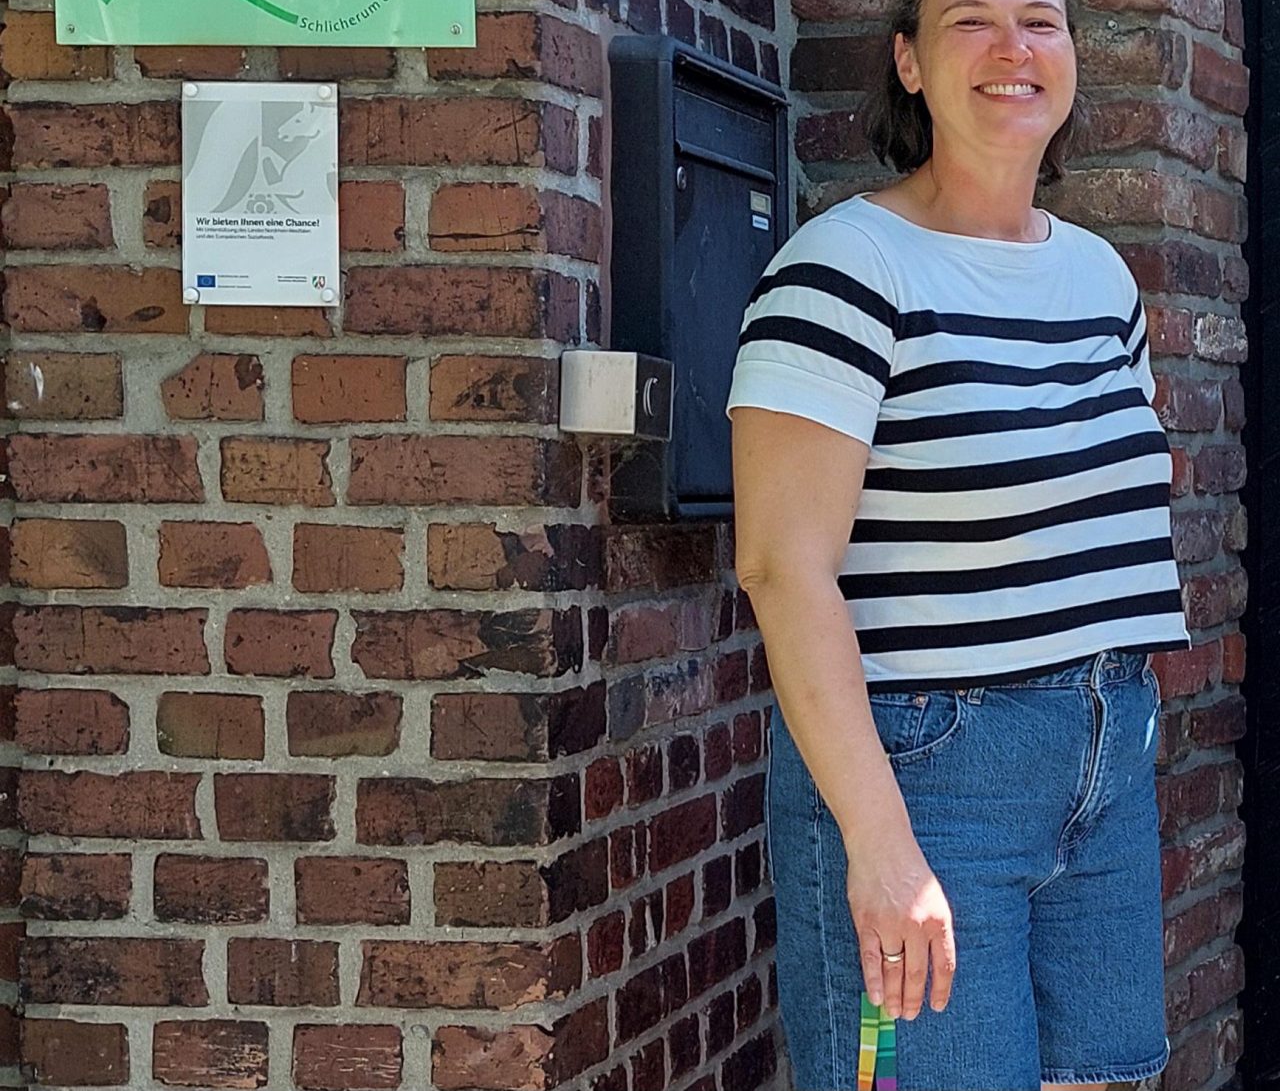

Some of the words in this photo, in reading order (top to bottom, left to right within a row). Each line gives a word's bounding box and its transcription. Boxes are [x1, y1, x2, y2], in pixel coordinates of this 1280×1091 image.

[299, 1, 381, 33] Schlicherum
[196, 217, 210, 226] Wir
[212, 217, 239, 226] bieten
[240, 218, 264, 226] Ihnen
[265, 218, 284, 227] eine
[285, 218, 320, 227] Chance!
